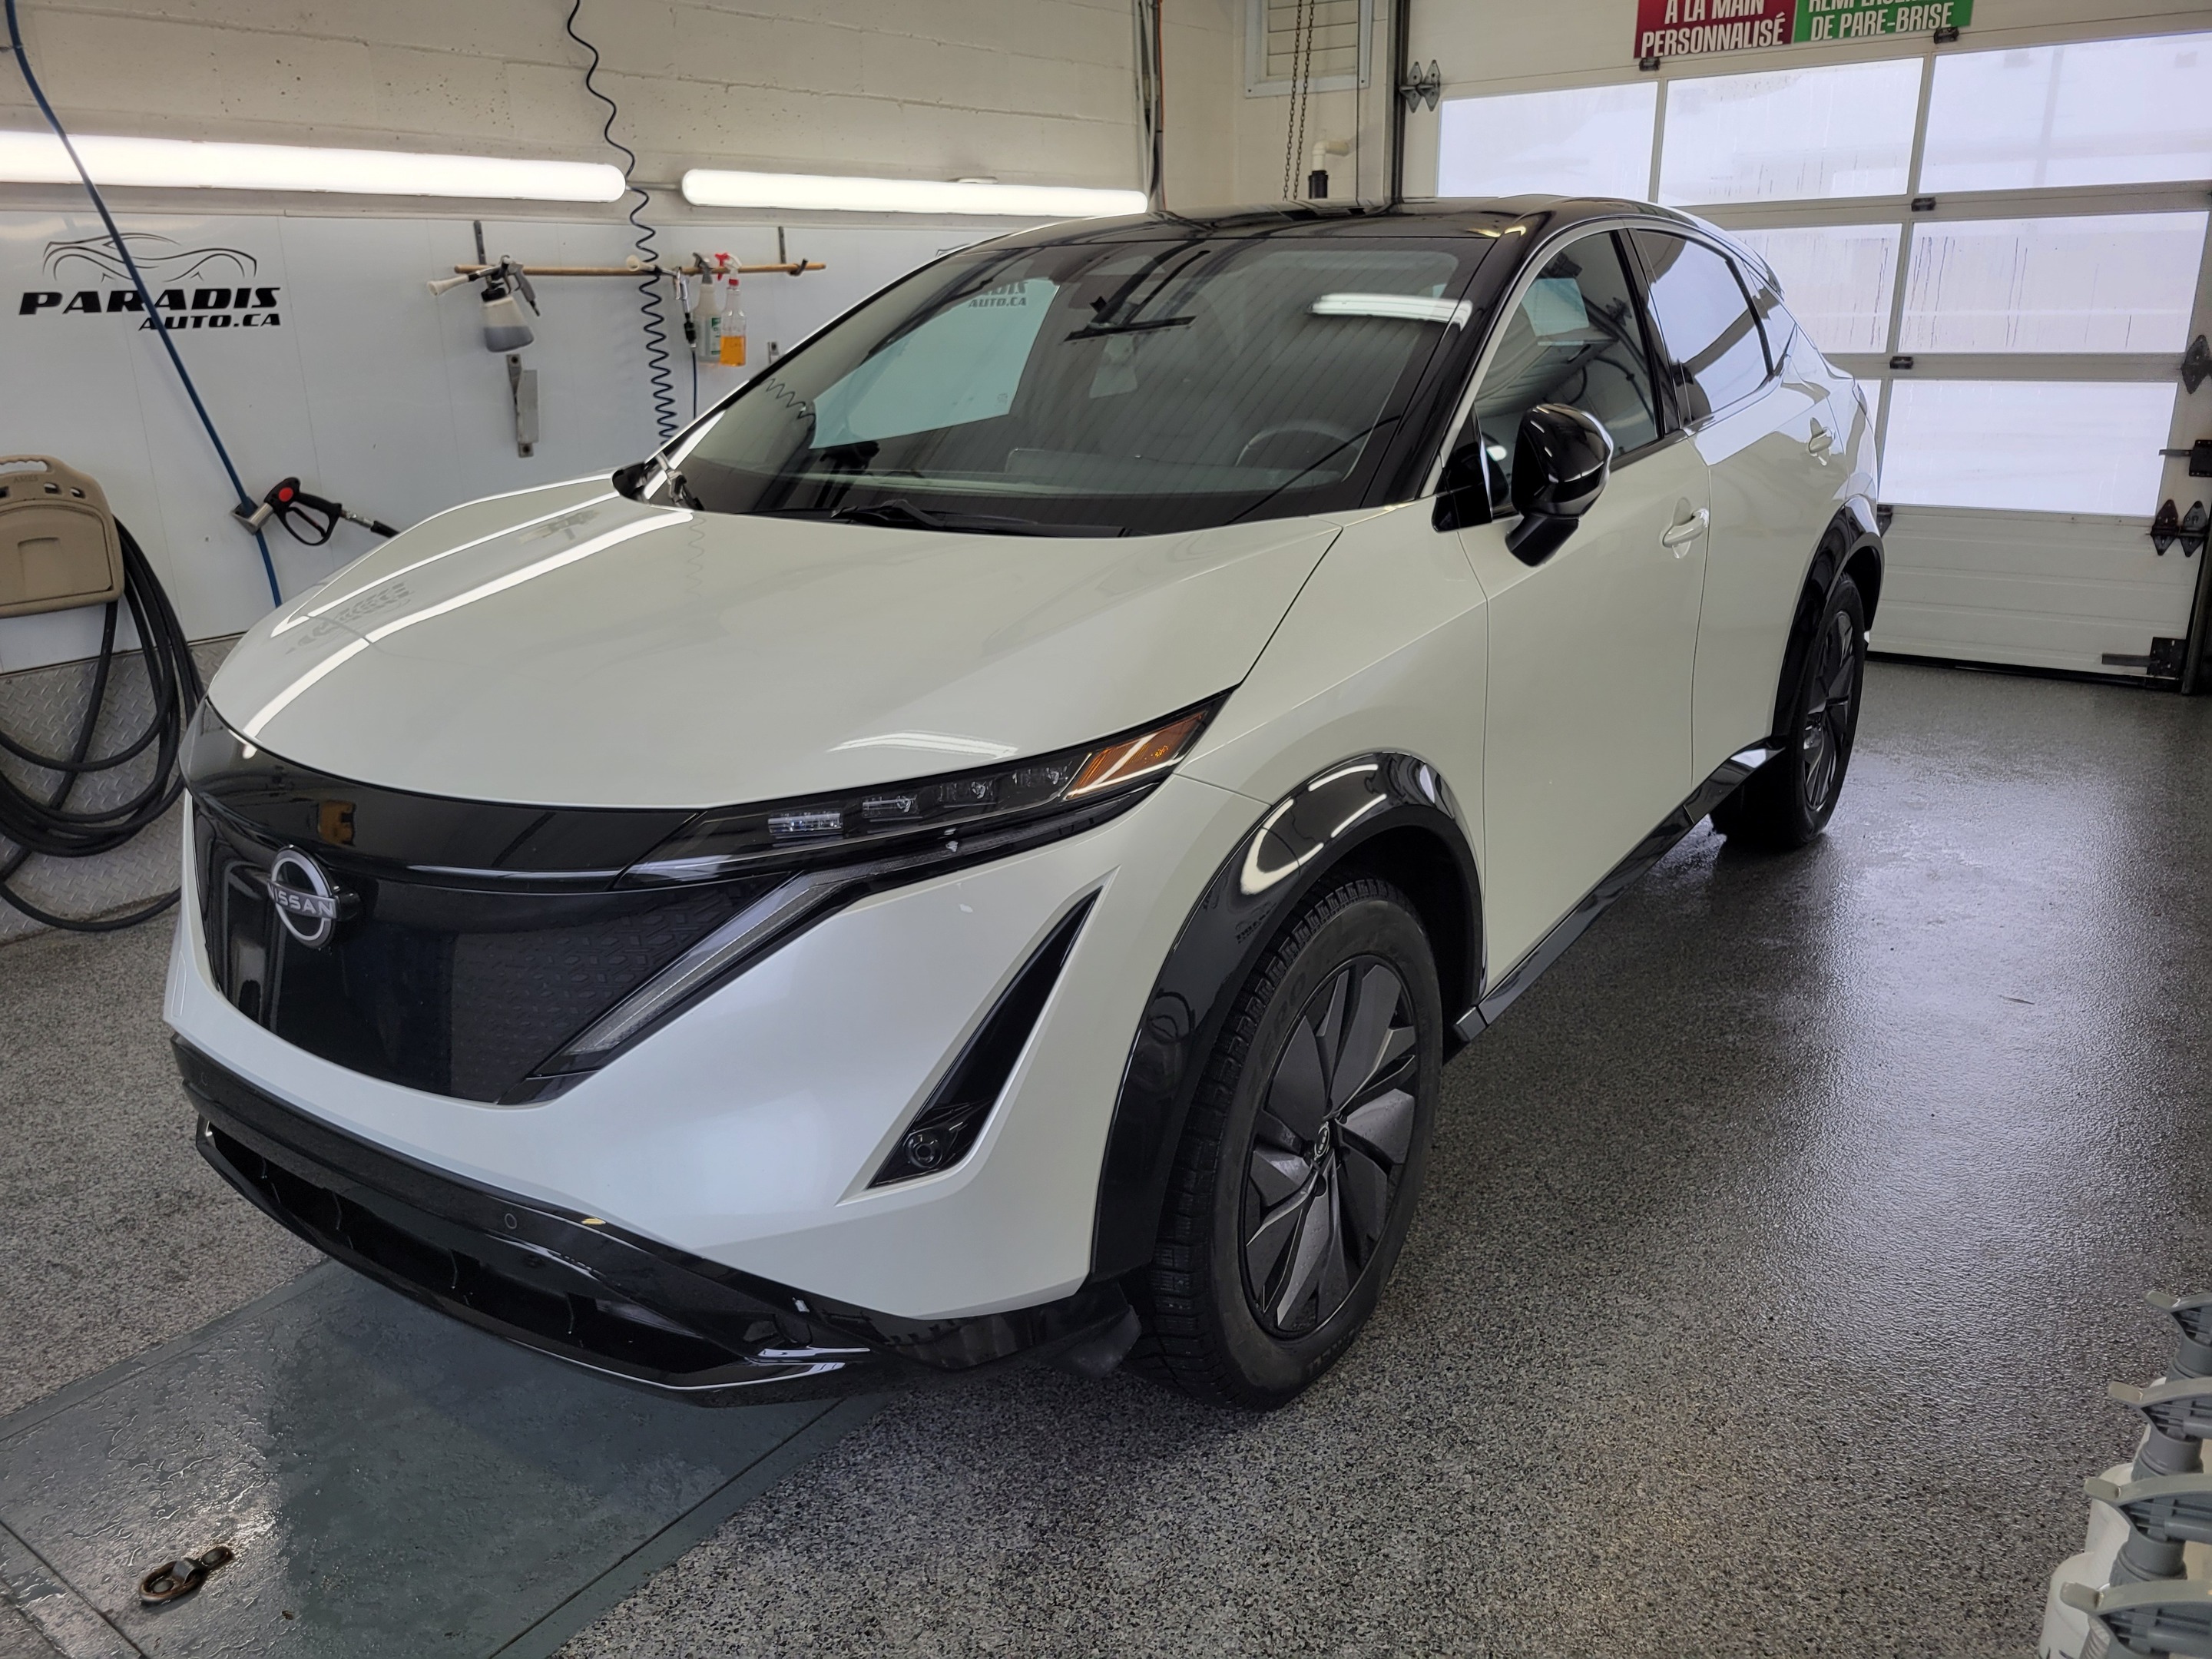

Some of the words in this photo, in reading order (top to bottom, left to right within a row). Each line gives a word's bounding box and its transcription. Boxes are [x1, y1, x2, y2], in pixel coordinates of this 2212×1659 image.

[1683, 0, 1706, 22] LA
[1711, 0, 1765, 20] MAIN
[1810, 15, 1836, 41] DE
[1839, 2, 1954, 38] PARE-BRISE
[1641, 12, 1786, 58] PERSONNALISÉ
[19, 287, 281, 315] PARADIS
[968, 297, 1027, 308] AUTO.CA
[137, 313, 281, 331] AUTO.CA
[267, 884, 334, 917] NISSAN
